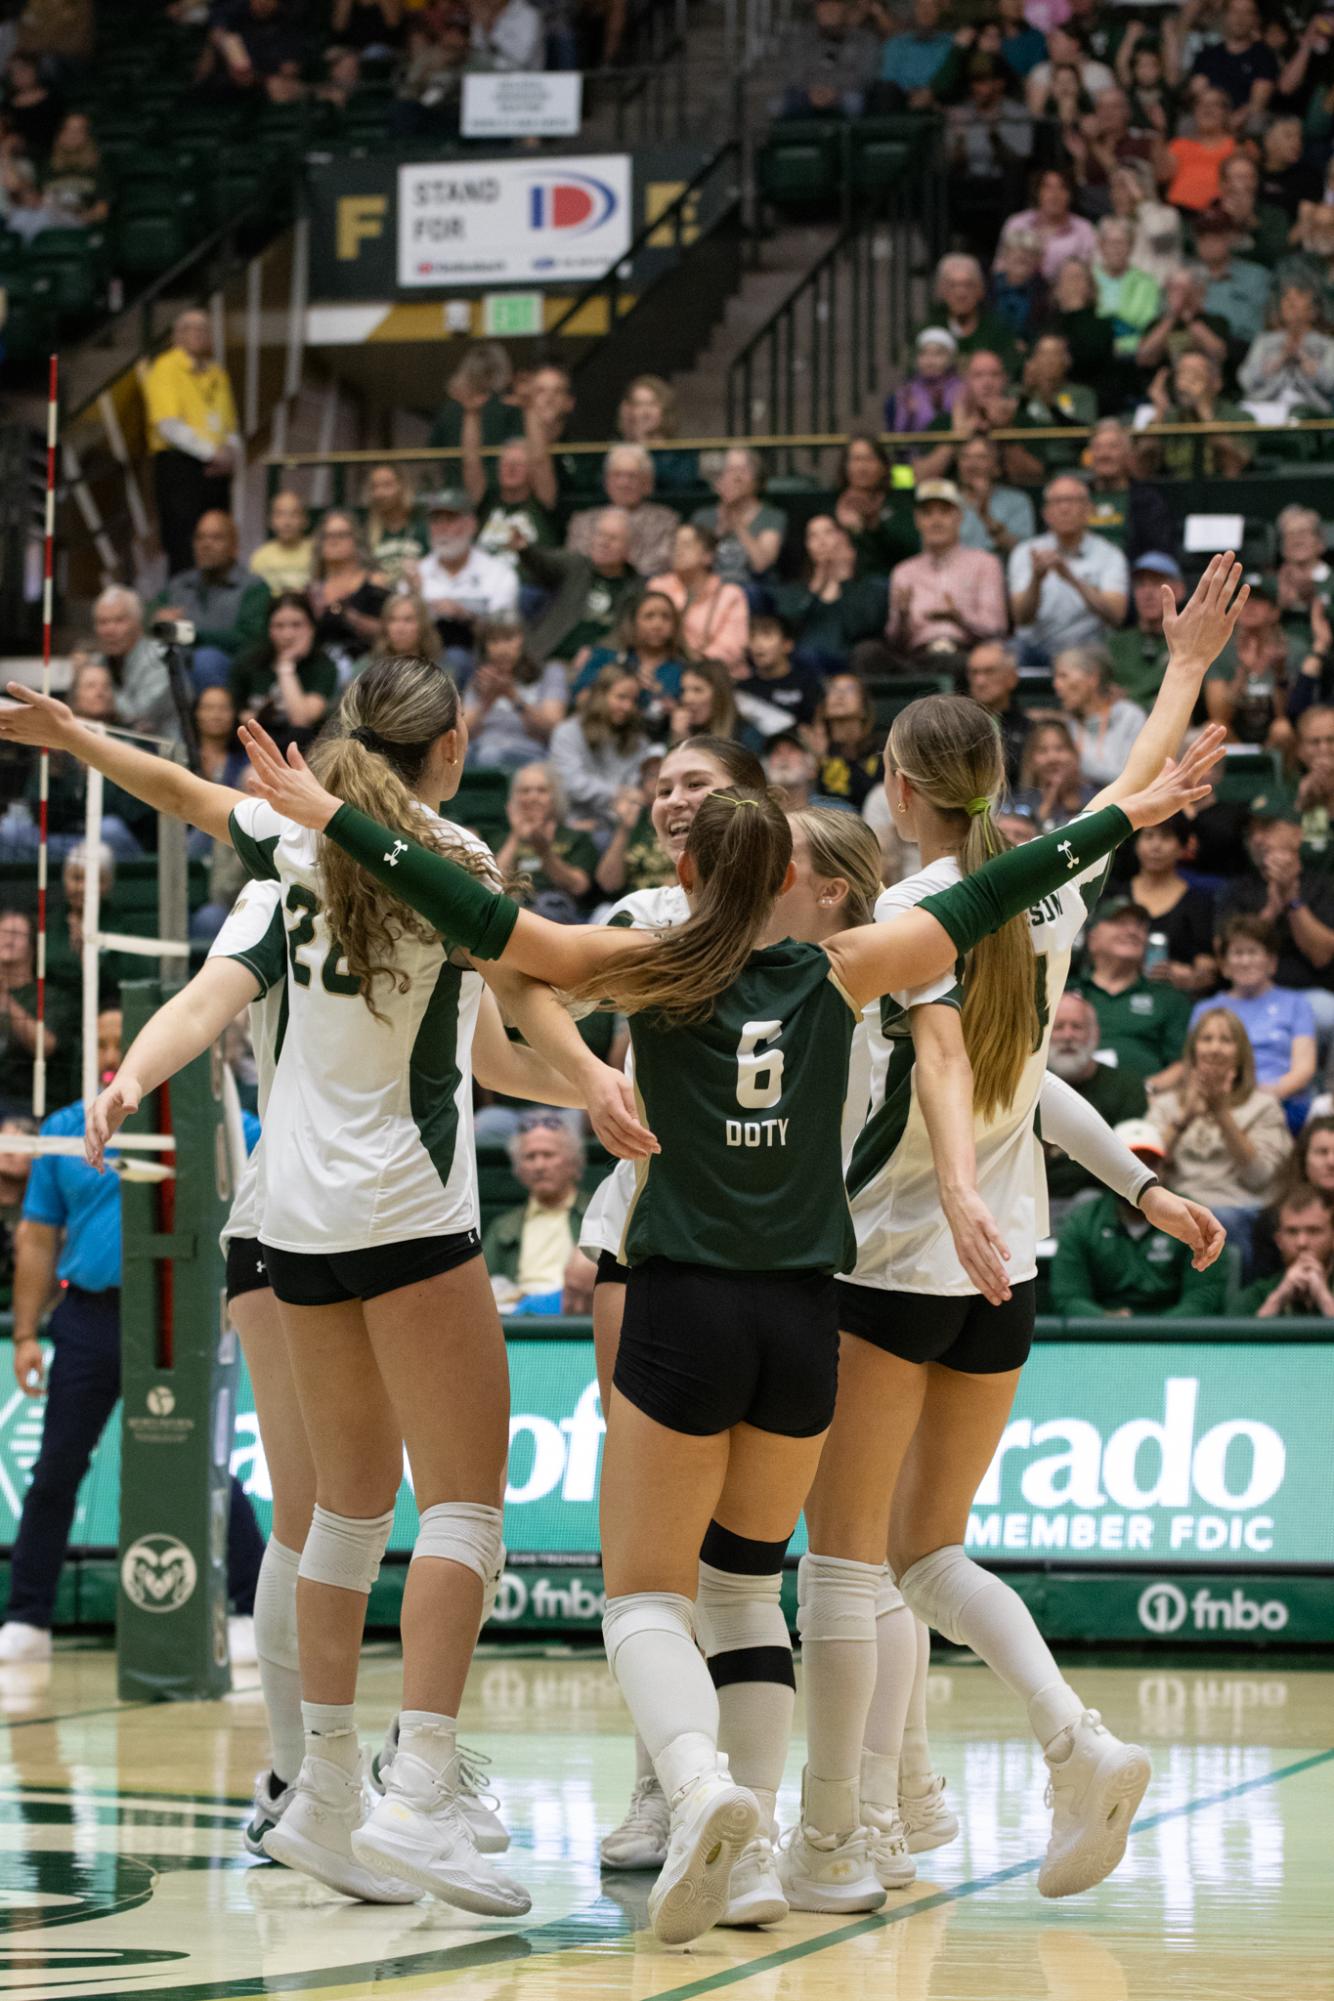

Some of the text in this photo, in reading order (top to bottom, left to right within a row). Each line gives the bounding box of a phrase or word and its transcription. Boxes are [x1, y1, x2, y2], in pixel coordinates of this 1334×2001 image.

[413, 177, 499, 206] STAND
[336, 195, 387, 260] F
[413, 216, 464, 241] FOR
[736, 1019, 785, 1109] 6
[725, 1118, 790, 1147] DOTY
[503, 1378, 607, 1503] of
[964, 1513, 1274, 1552] MEMBER FDIC
[1191, 1588, 1288, 1630] fnbo
